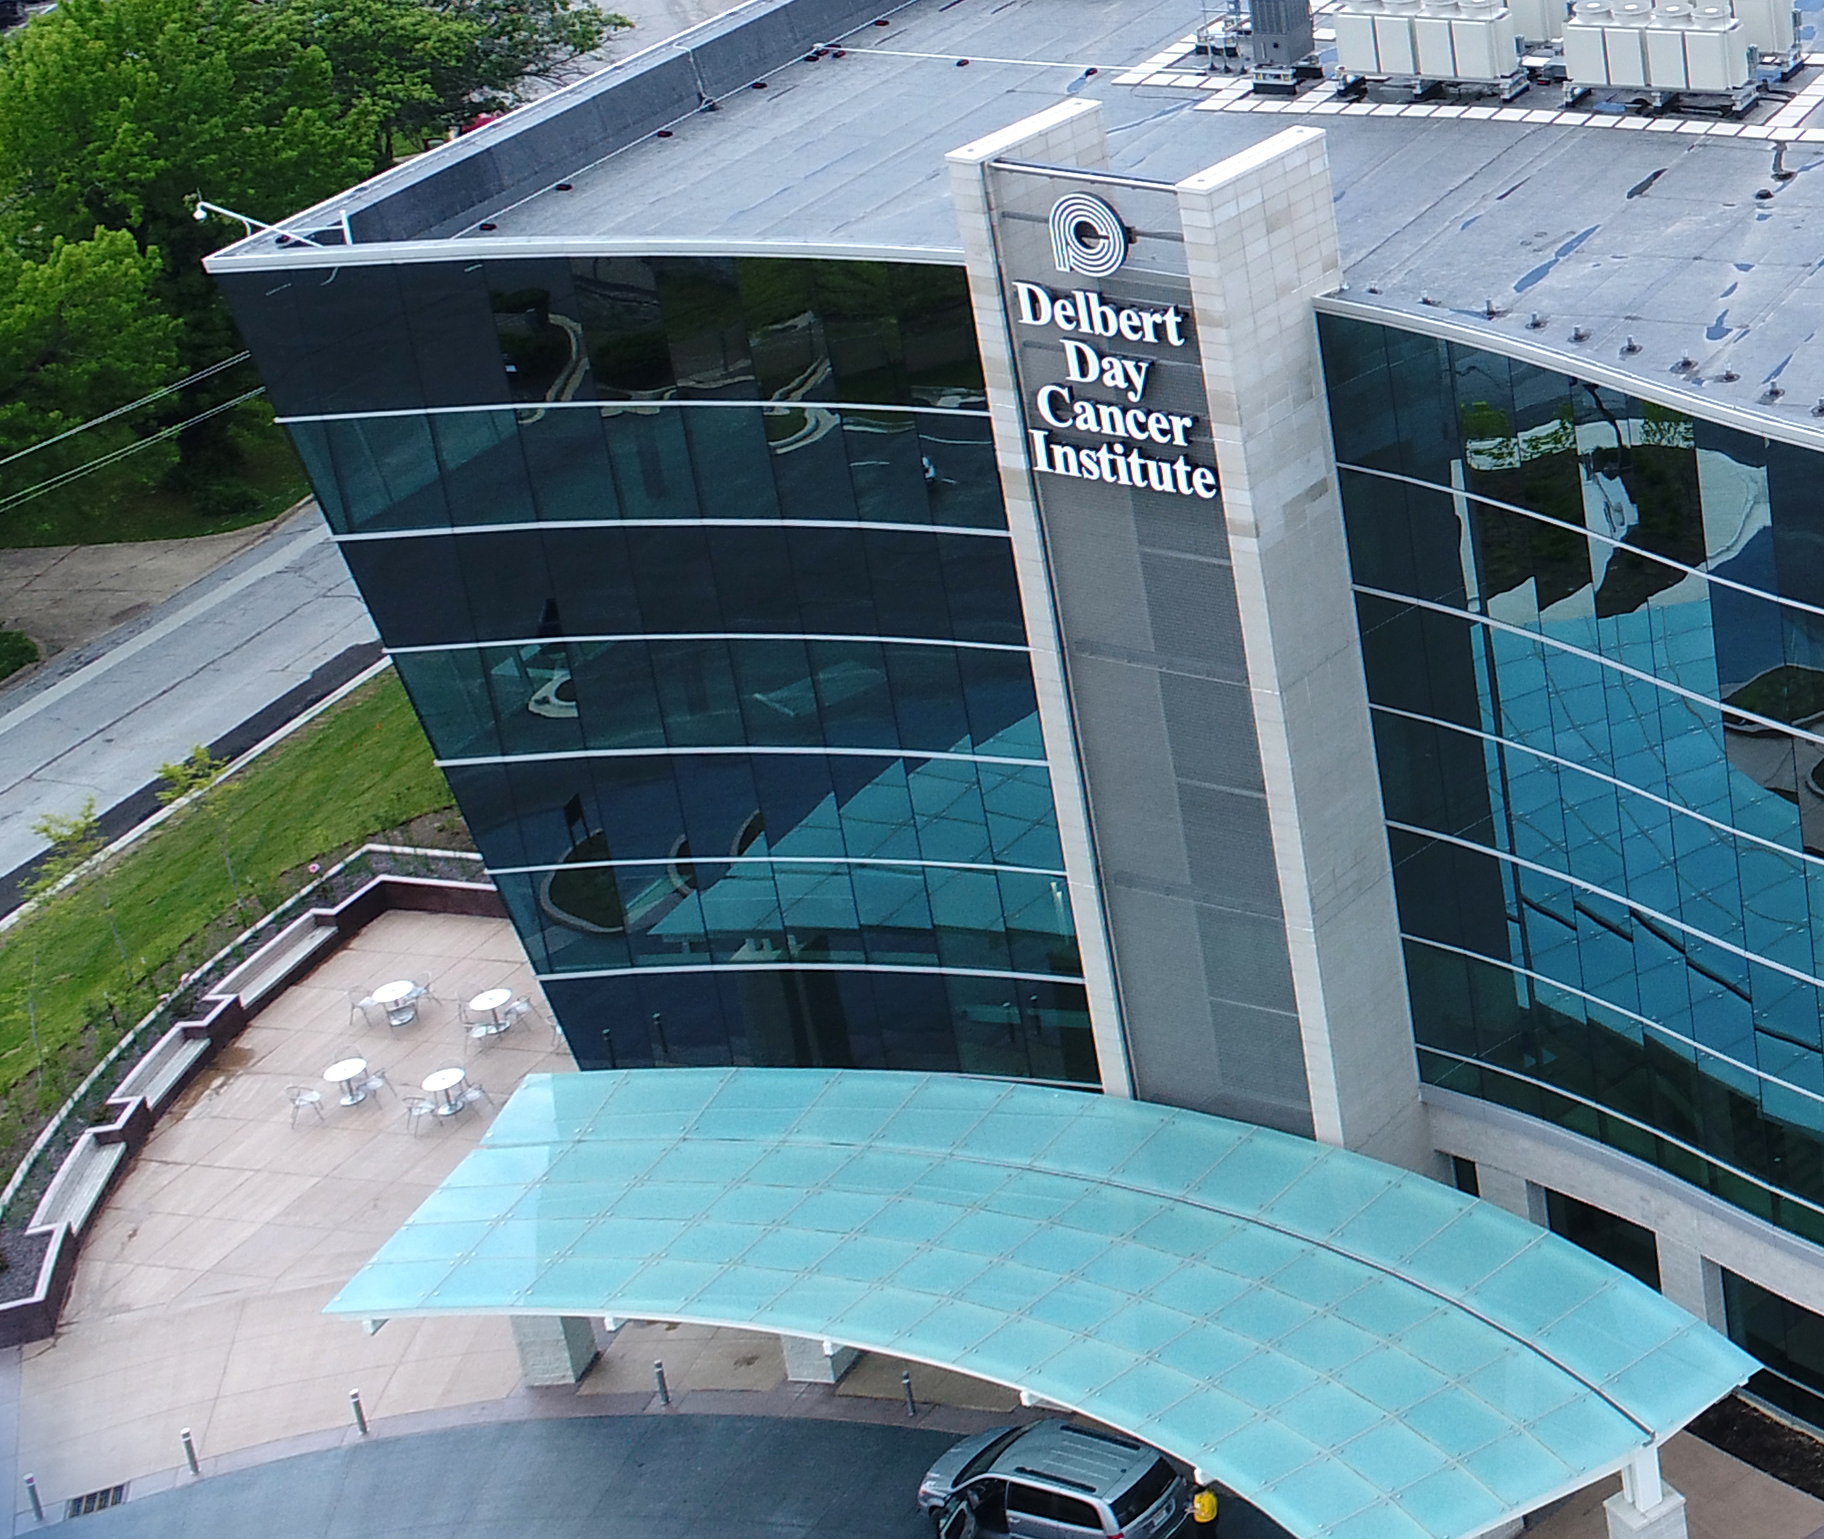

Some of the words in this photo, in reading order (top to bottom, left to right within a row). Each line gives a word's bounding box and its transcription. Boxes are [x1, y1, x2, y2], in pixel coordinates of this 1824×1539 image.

[1011, 281, 1186, 346] Delbert
[1058, 339, 1149, 402] Day
[1037, 384, 1193, 447] Cancer
[1029, 429, 1219, 499] Institute
